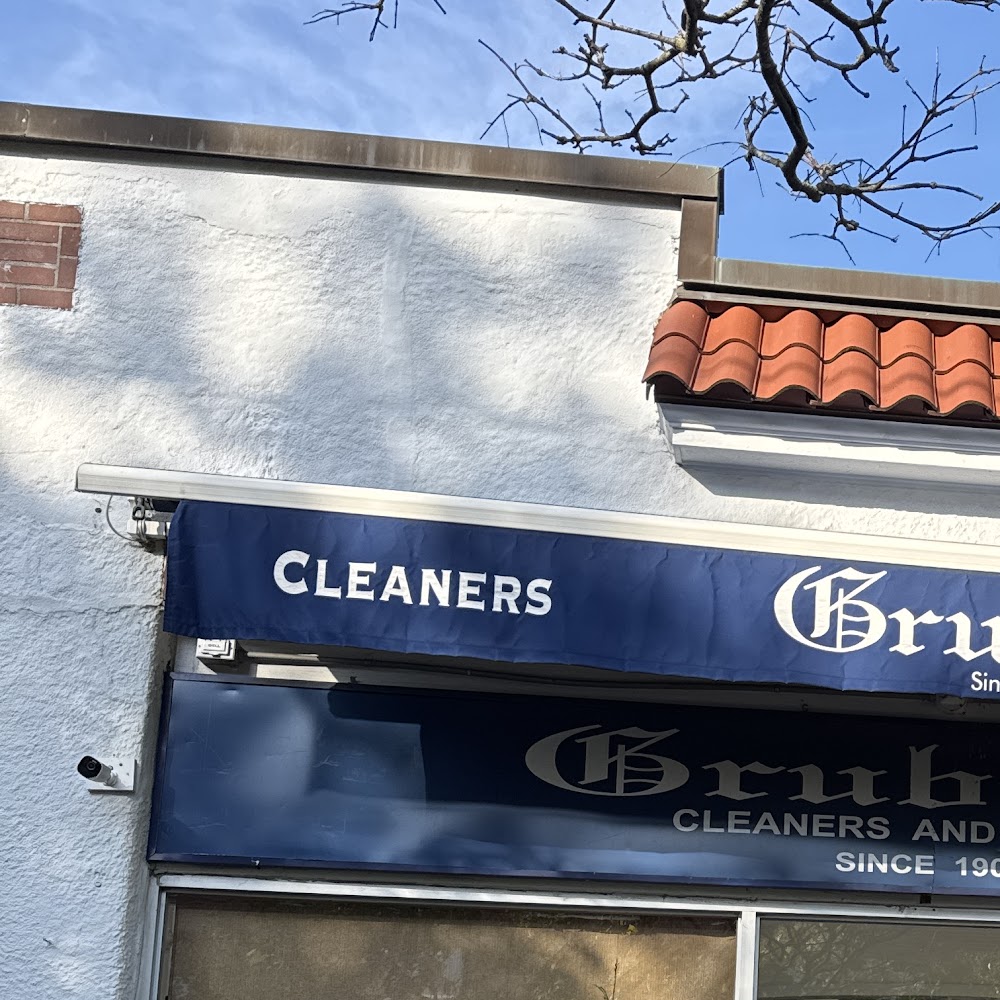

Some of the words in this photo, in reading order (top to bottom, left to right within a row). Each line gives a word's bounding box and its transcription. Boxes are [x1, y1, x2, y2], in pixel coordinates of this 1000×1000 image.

[273, 550, 553, 616] CLEANERS
[672, 808, 891, 842] CLEANERS
[911, 819, 996, 845] AND
[834, 851, 935, 875] SINCE
